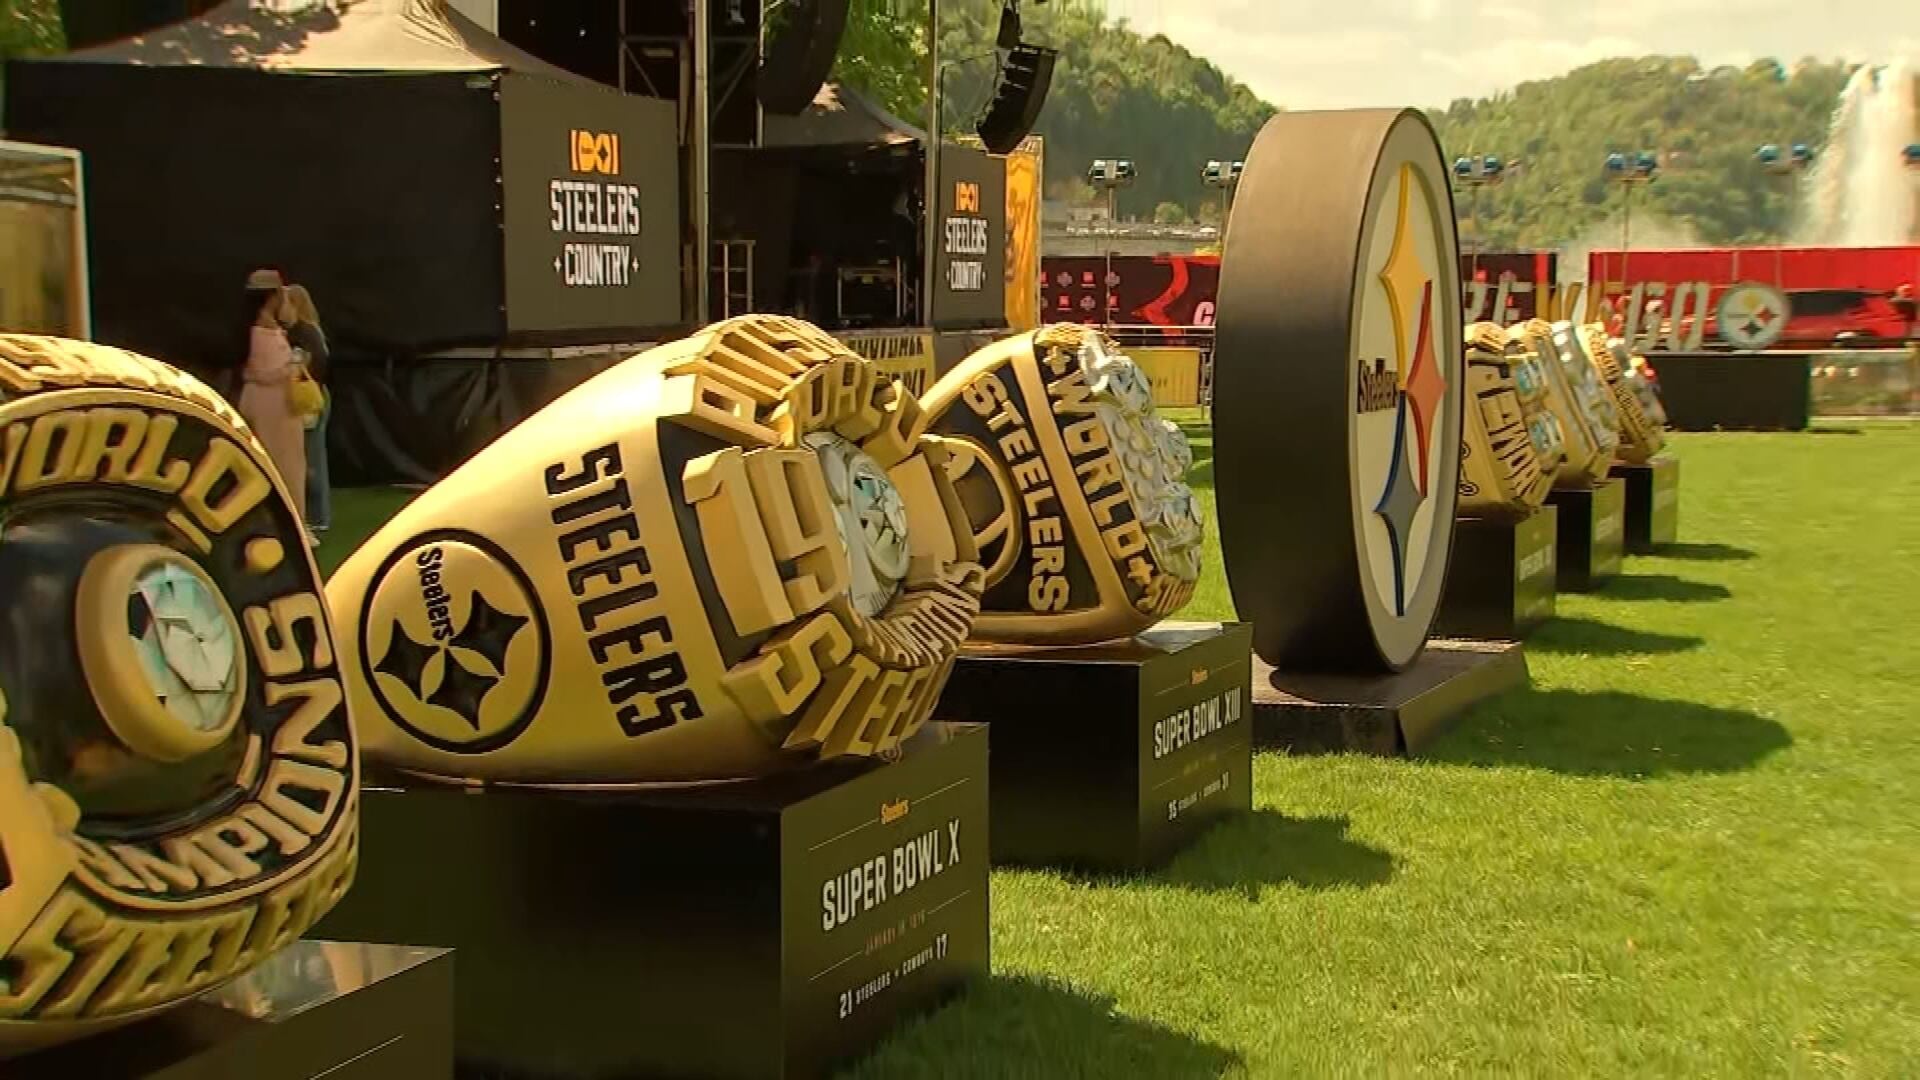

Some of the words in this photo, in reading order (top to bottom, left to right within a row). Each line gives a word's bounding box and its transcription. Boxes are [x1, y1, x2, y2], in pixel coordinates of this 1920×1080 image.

[550, 179, 640, 235] STEELERS
[945, 217, 988, 254] STEELERS
[564, 243, 630, 286] COUNTRY
[950, 261, 982, 290] COUNTRY
[960, 370, 1070, 613] STEELERS
[1046, 368, 1148, 563] WORLD
[415, 546, 455, 642] Steelers
[544, 441, 705, 738] STEELERS
[1154, 709, 1191, 759] SUPER
[1192, 695, 1222, 741] BOWL
[1223, 686, 1241, 725] XIII
[822, 855, 887, 932] SUPER
[892, 829, 943, 896] BOWL
[948, 818, 961, 868] X
[839, 989, 853, 1019] 21
[936, 932, 948, 961] 17
